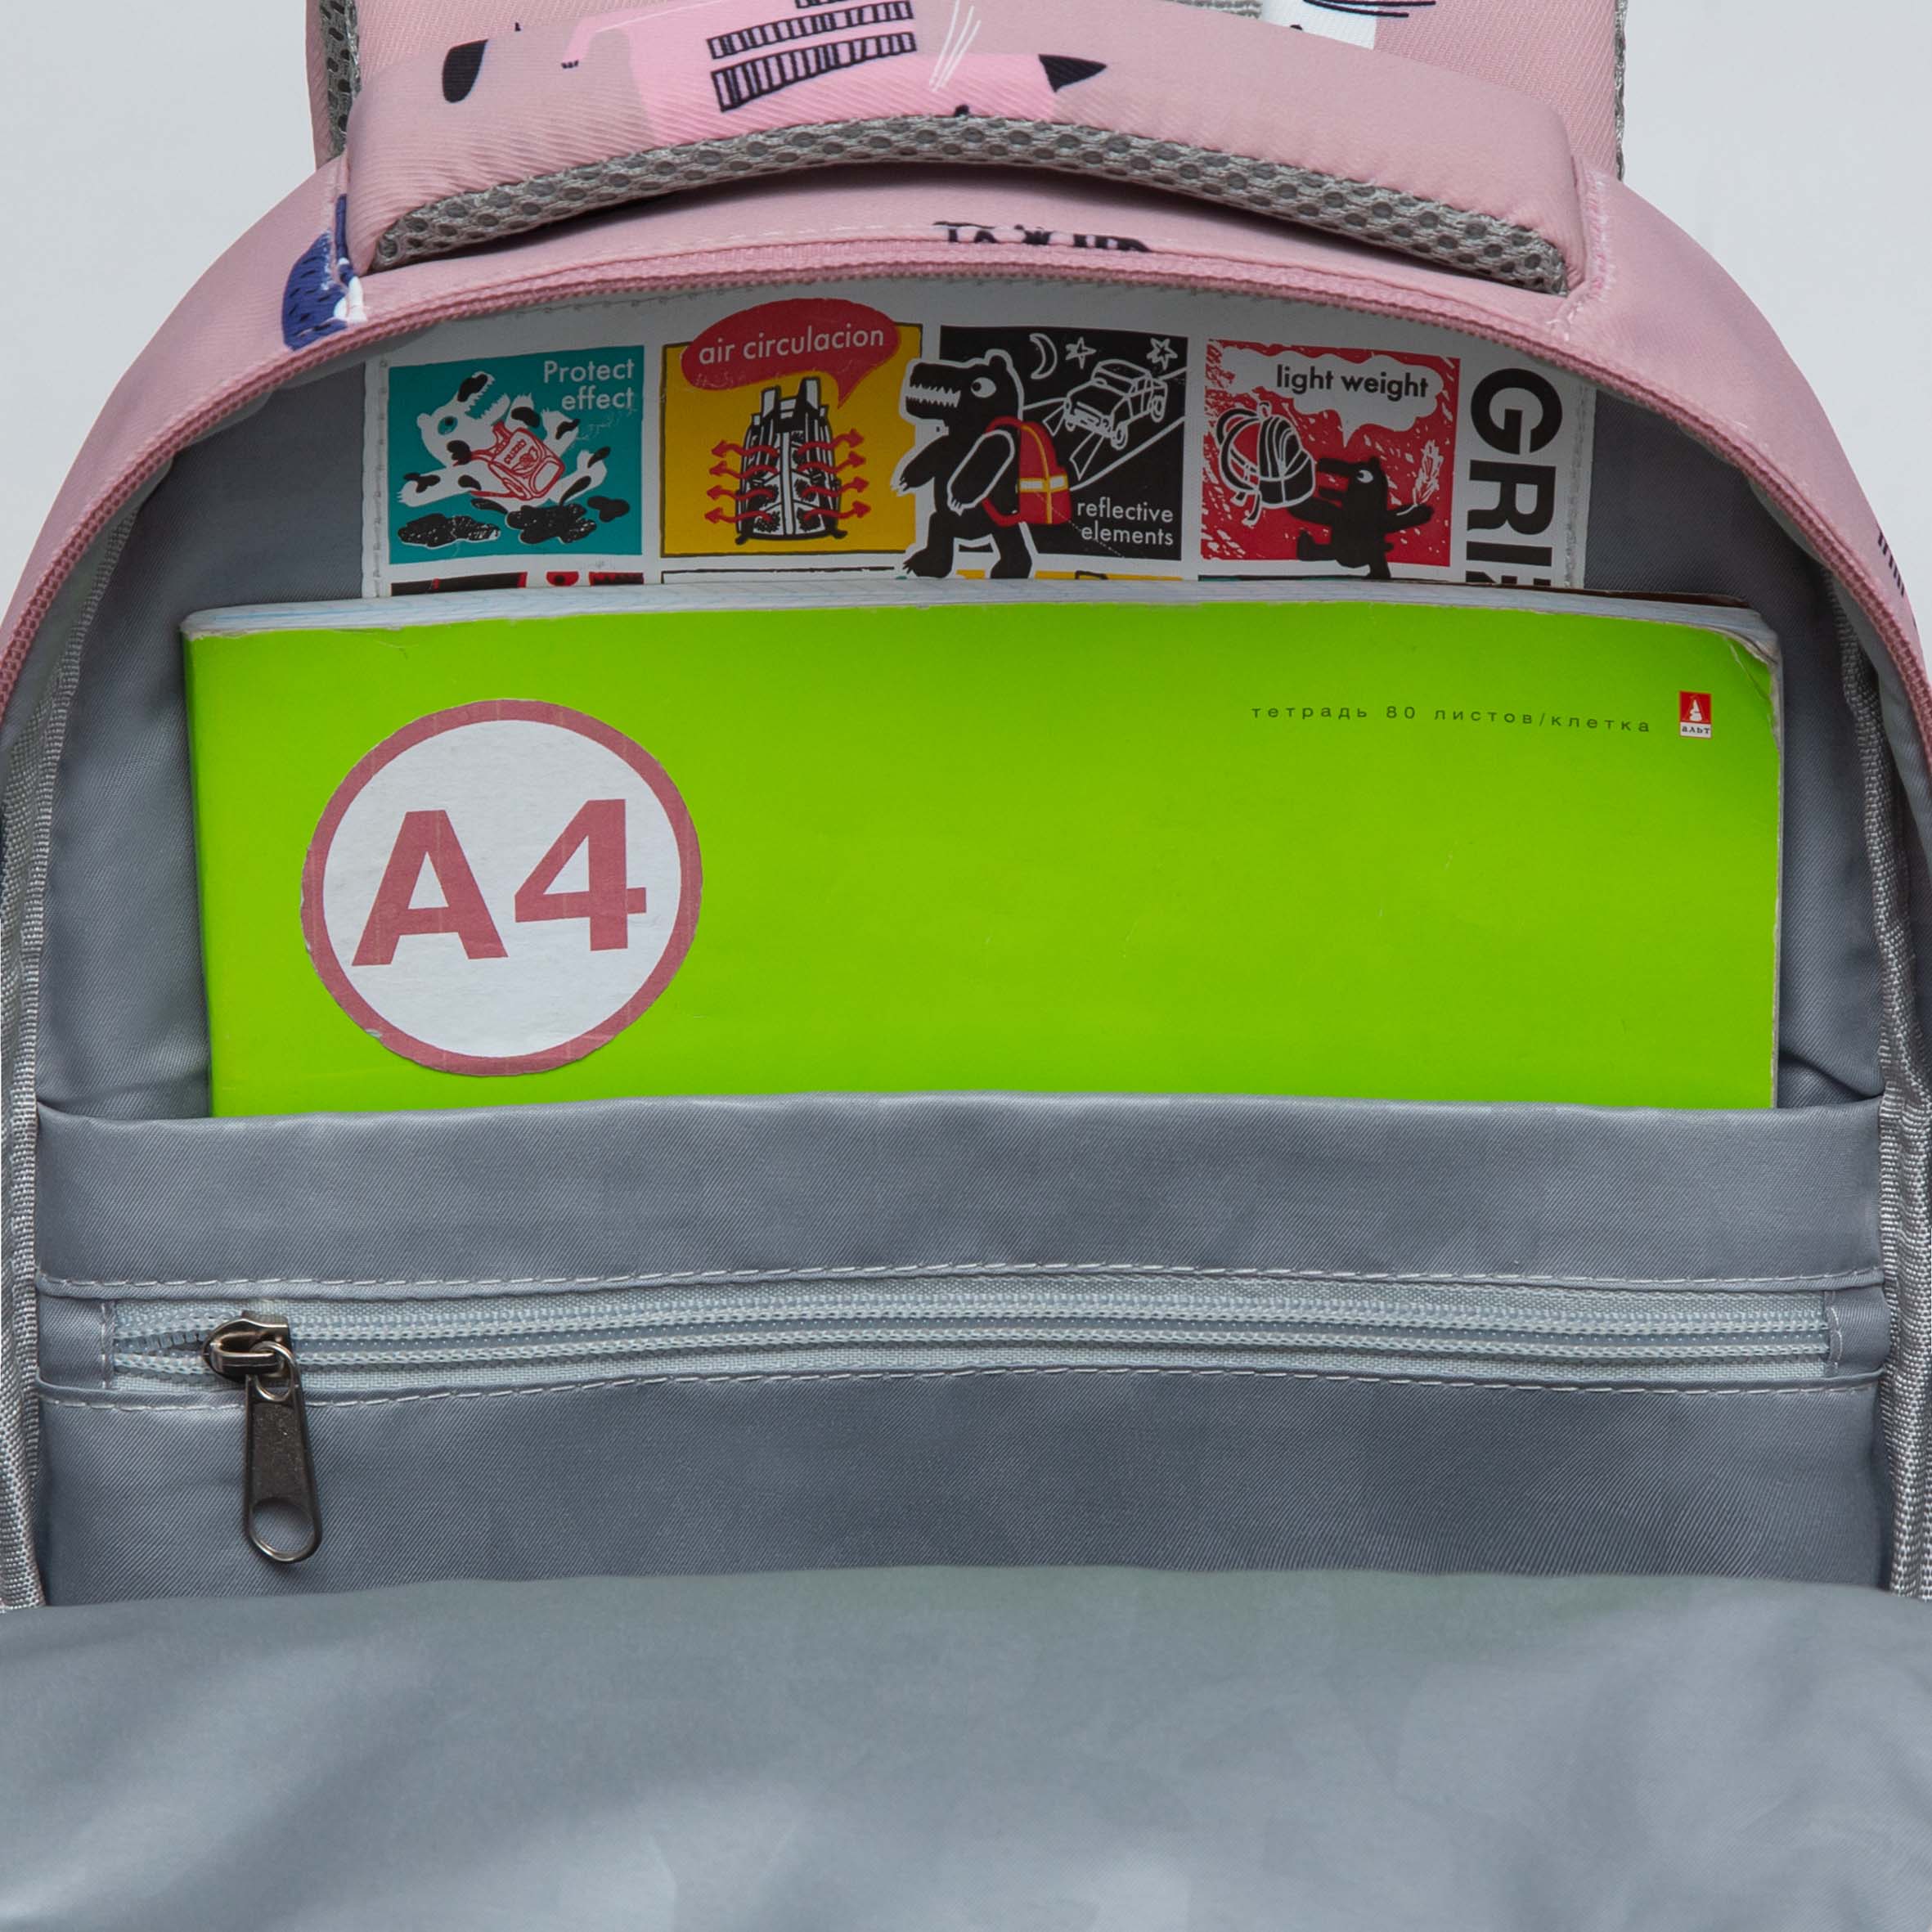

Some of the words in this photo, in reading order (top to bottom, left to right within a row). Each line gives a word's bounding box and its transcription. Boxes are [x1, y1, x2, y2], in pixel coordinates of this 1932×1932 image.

[699, 339, 735, 365] air
[743, 325, 884, 360] circulacion
[543, 358, 635, 384] Protect
[1276, 363, 1335, 393] light
[1340, 372, 1430, 399] weight
[561, 386, 634, 410] effect
[1465, 367, 1563, 586] GRI
[1076, 497, 1175, 524] reflective
[1080, 523, 1175, 546] elements
[1251, 706, 1368, 720] тетрадь
[1386, 705, 1417, 720] 80
[1433, 709, 1651, 734] листов/клетка
[352, 798, 647, 967] A4
